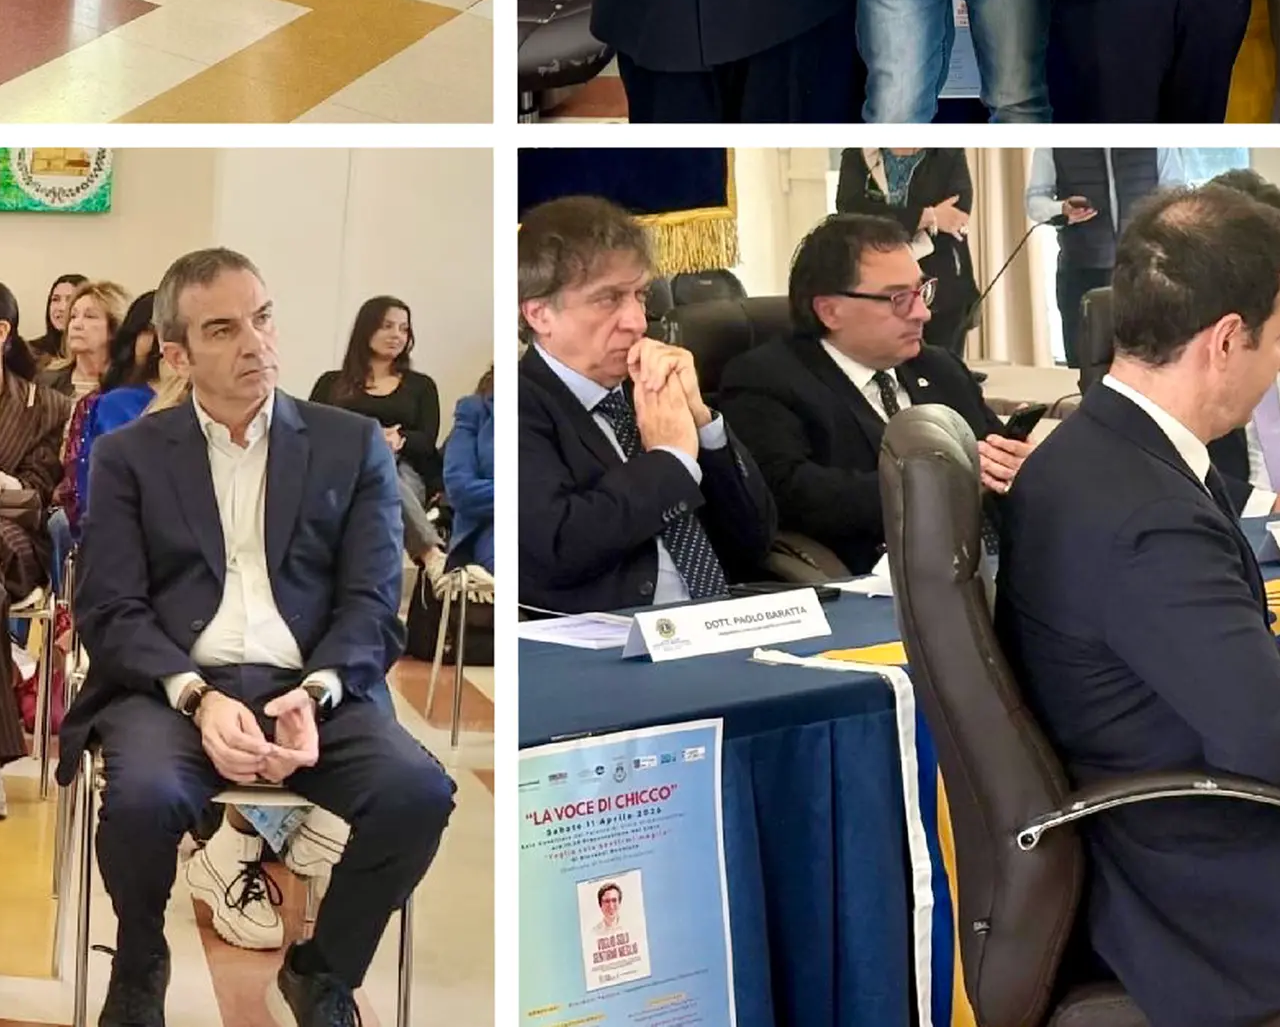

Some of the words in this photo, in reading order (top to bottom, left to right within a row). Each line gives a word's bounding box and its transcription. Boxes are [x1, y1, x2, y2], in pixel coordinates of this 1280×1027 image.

[704, 618, 733, 630] DOTT.
[733, 612, 764, 624] PAOLO
[765, 606, 807, 620] BARATTA
[554, 801, 595, 821] VOCE
[598, 796, 612, 812] DI
[599, 813, 633, 827] Aprile
